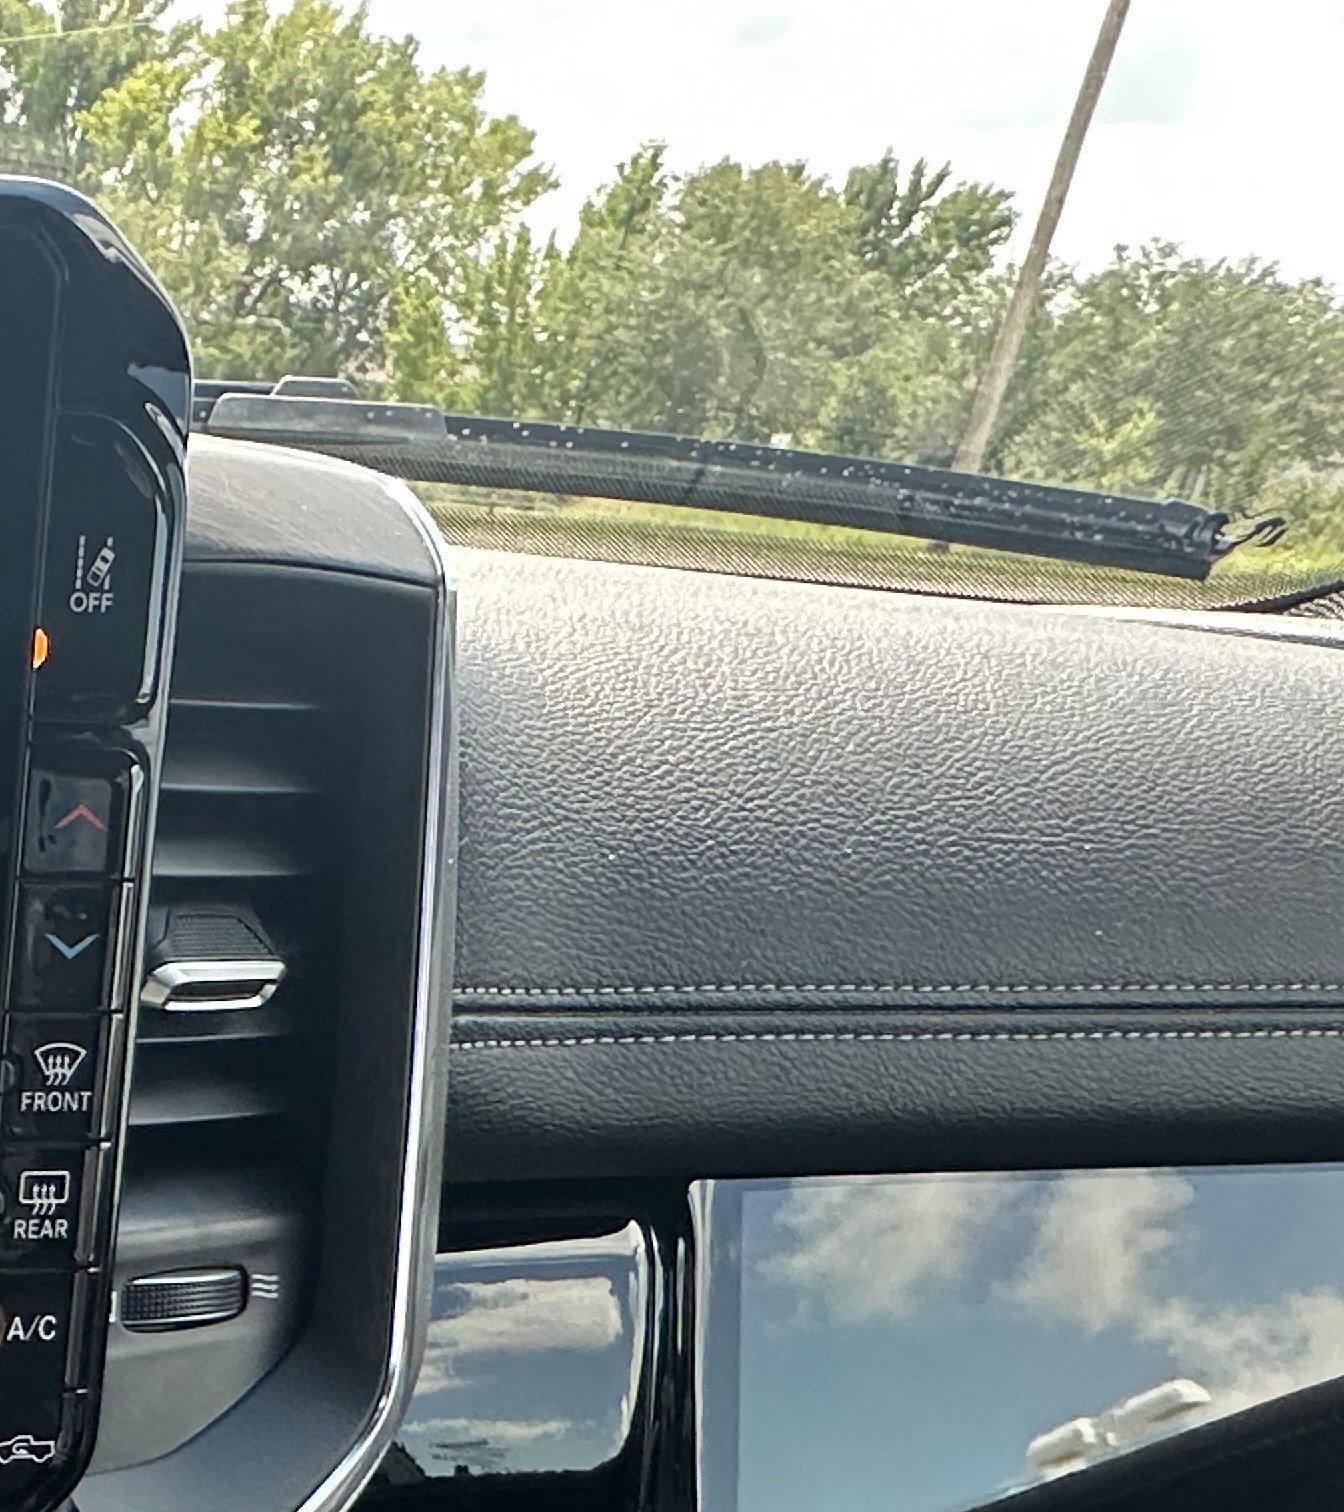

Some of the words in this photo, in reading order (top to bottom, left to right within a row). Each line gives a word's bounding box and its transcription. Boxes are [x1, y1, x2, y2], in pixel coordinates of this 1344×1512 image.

[69, 591, 114, 613] OFF
[20, 1091, 92, 1113] FRONT
[13, 1218, 69, 1240] REAR
[6, 1314, 57, 1342] A/C
